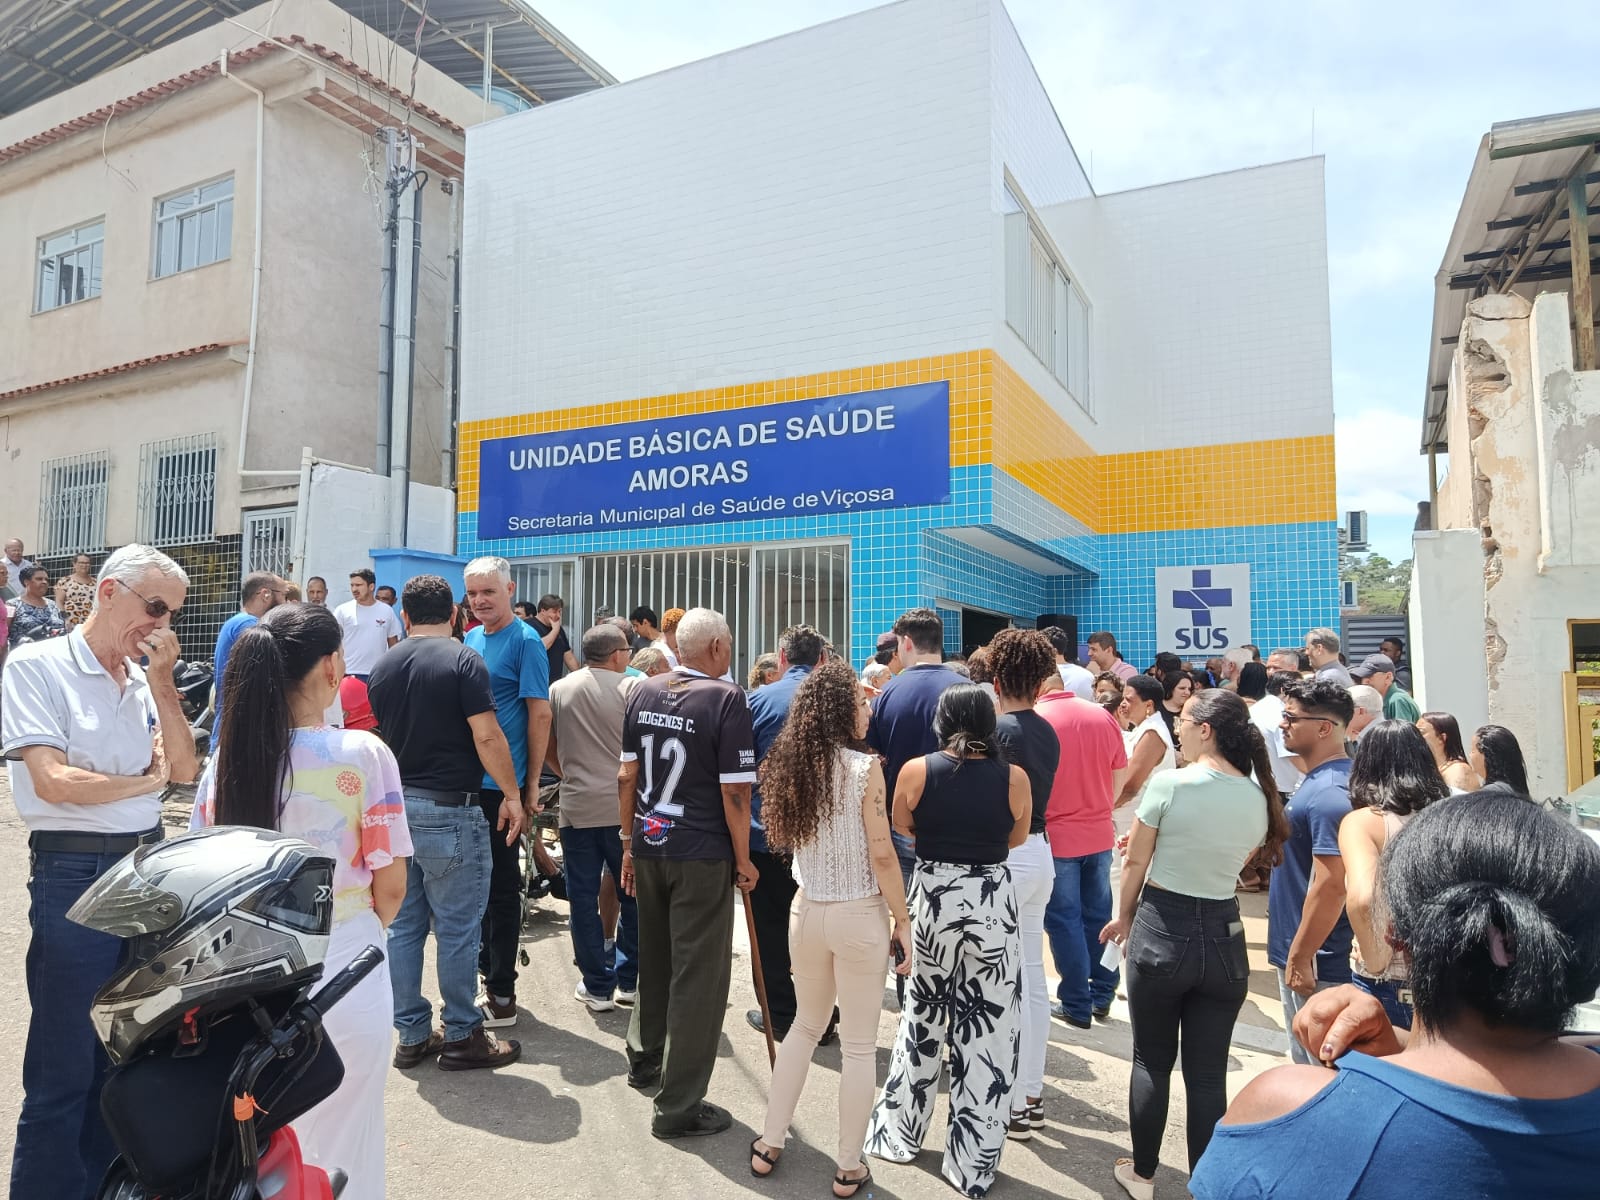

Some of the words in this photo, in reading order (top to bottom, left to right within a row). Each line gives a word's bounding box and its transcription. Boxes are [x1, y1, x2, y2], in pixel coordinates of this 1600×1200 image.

[509, 439, 622, 471] UNIDADE
[629, 428, 732, 458] BÁSICA
[738, 421, 777, 446] DE
[785, 405, 896, 441] SAÚDE
[628, 460, 749, 493] AMORAS
[508, 511, 594, 531] Secretaria
[600, 503, 686, 527] Municipal
[691, 500, 716, 517] de
[721, 493, 786, 515] Saúde
[792, 491, 818, 509] de
[820, 486, 895, 512] Viçosa
[1175, 628, 1229, 650] SUS
[637, 710, 684, 731] DIOGENES
[638, 734, 686, 817] 12
